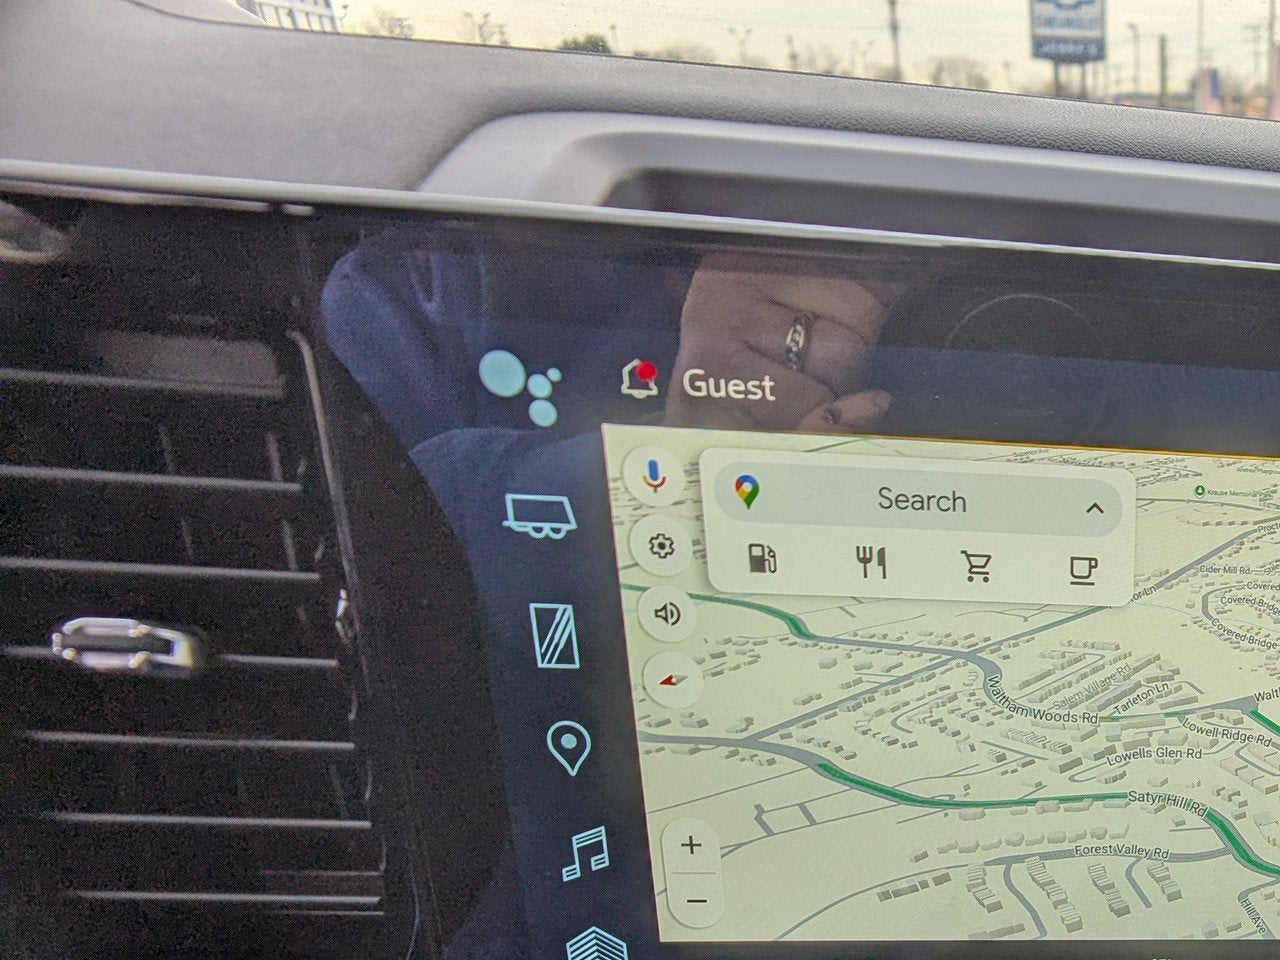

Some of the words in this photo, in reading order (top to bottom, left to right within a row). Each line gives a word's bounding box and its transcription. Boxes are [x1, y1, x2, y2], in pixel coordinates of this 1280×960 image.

[683, 368, 777, 402] Guest
[878, 486, 967, 512] Search
[1200, 564, 1221, 574] Cider
[1223, 565, 1238, 575] Mill
[1239, 566, 1251, 575] Rd
[1143, 585, 1157, 596] Ln
[1246, 581, 1280, 591] Covered
[1220, 595, 1256, 606] Covered
[1211, 617, 1248, 643] Covered
[1247, 634, 1278, 651] Bridge
[987, 674, 1030, 718] Waltham
[1031, 707, 1079, 723] Woods
[1081, 711, 1099, 724] Rd
[1052, 690, 1084, 710] Salem
[1083, 673, 1117, 695] Village
[1114, 663, 1132, 676] Rd
[1113, 688, 1154, 715] Tarleton
[1154, 682, 1169, 694] Ln
[1181, 717, 1219, 738] Lowell
[1220, 727, 1254, 746] Ridge
[1255, 733, 1273, 748] Rd
[1106, 748, 1153, 767] Lowells
[1155, 747, 1183, 759] Glen
[1186, 748, 1202, 759] Rd
[1128, 790, 1166, 806] Satyr
[1165, 793, 1188, 811] Hill
[1189, 801, 1209, 818] Rd
[1074, 843, 1114, 856] Forest
[1115, 843, 1150, 859] Valley
[1152, 847, 1170, 860] Rd
